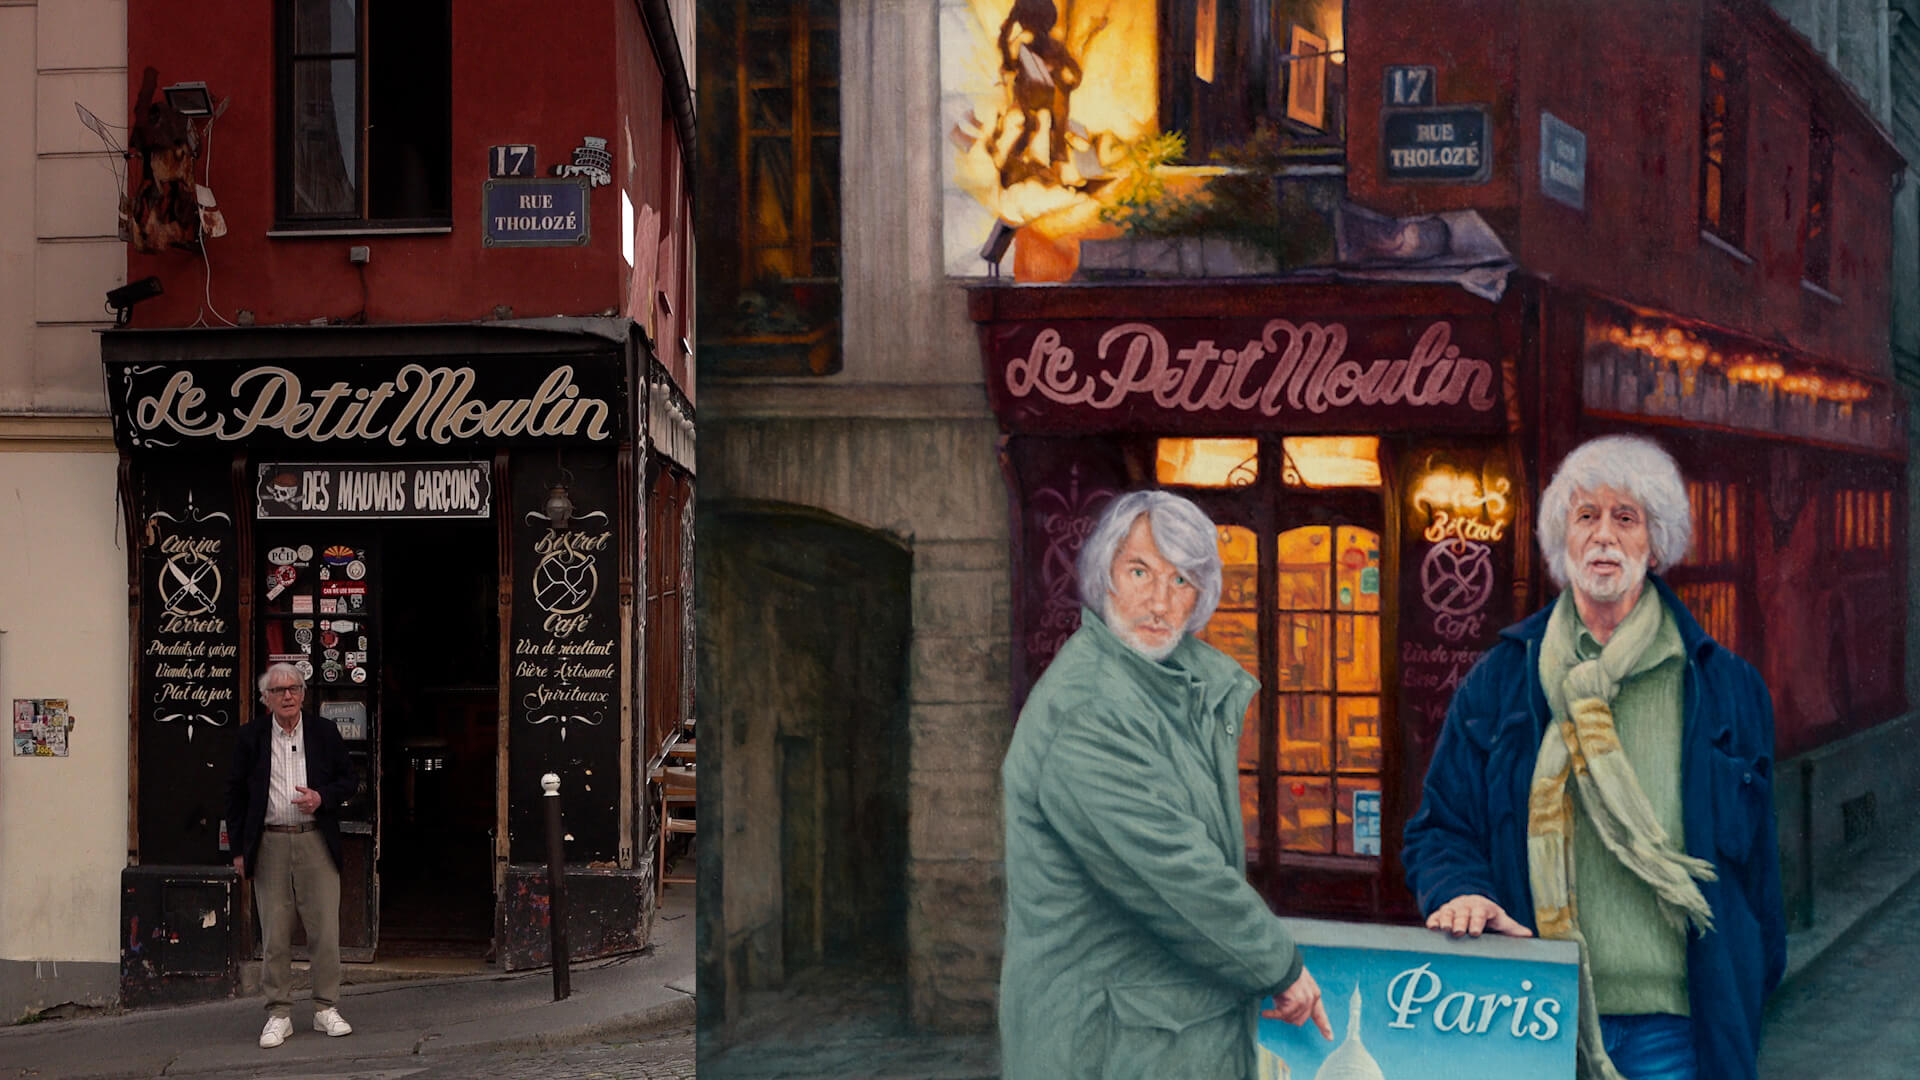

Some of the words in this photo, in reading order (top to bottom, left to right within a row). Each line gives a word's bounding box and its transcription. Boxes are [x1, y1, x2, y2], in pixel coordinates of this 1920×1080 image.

[1393, 69, 1427, 103] 17
[1416, 124, 1454, 142] RUE
[496, 146, 528, 176] 17
[1390, 141, 1479, 168] THOLOZÉ
[520, 195, 553, 208] RUE
[495, 211, 577, 231] THOLOZÉ
[1006, 328, 1096, 404] Le
[1088, 323, 1264, 411] Petit
[1260, 319, 1496, 416] Moulin
[137, 371, 225, 436] Le
[216, 366, 395, 442] Petit
[388, 363, 609, 446] Moulin
[302, 471, 330, 511] DES
[337, 471, 406, 511] MAUVAIS
[414, 469, 480, 512] GARÇONS
[160, 534, 221, 565] Cuisine
[534, 528, 612, 563] Bistrot
[159, 611, 226, 634] Terroir
[543, 613, 592, 638] Café
[145, 640, 192, 657] Produits
[193, 641, 206, 656] de
[516, 639, 539, 655] Vin
[541, 639, 556, 655] de
[558, 640, 615, 655] récoltant
[155, 663, 193, 679] Viandes
[193, 663, 206, 678] de
[207, 666, 232, 678] race
[515, 661, 548, 678] Bière
[554, 662, 615, 681] Artisanale
[153, 683, 191, 703] Plat
[191, 686, 207, 700] du
[201, 688, 233, 707] jour
[523, 683, 609, 710] Spiritueux
[1387, 962, 1561, 1041] Paris
